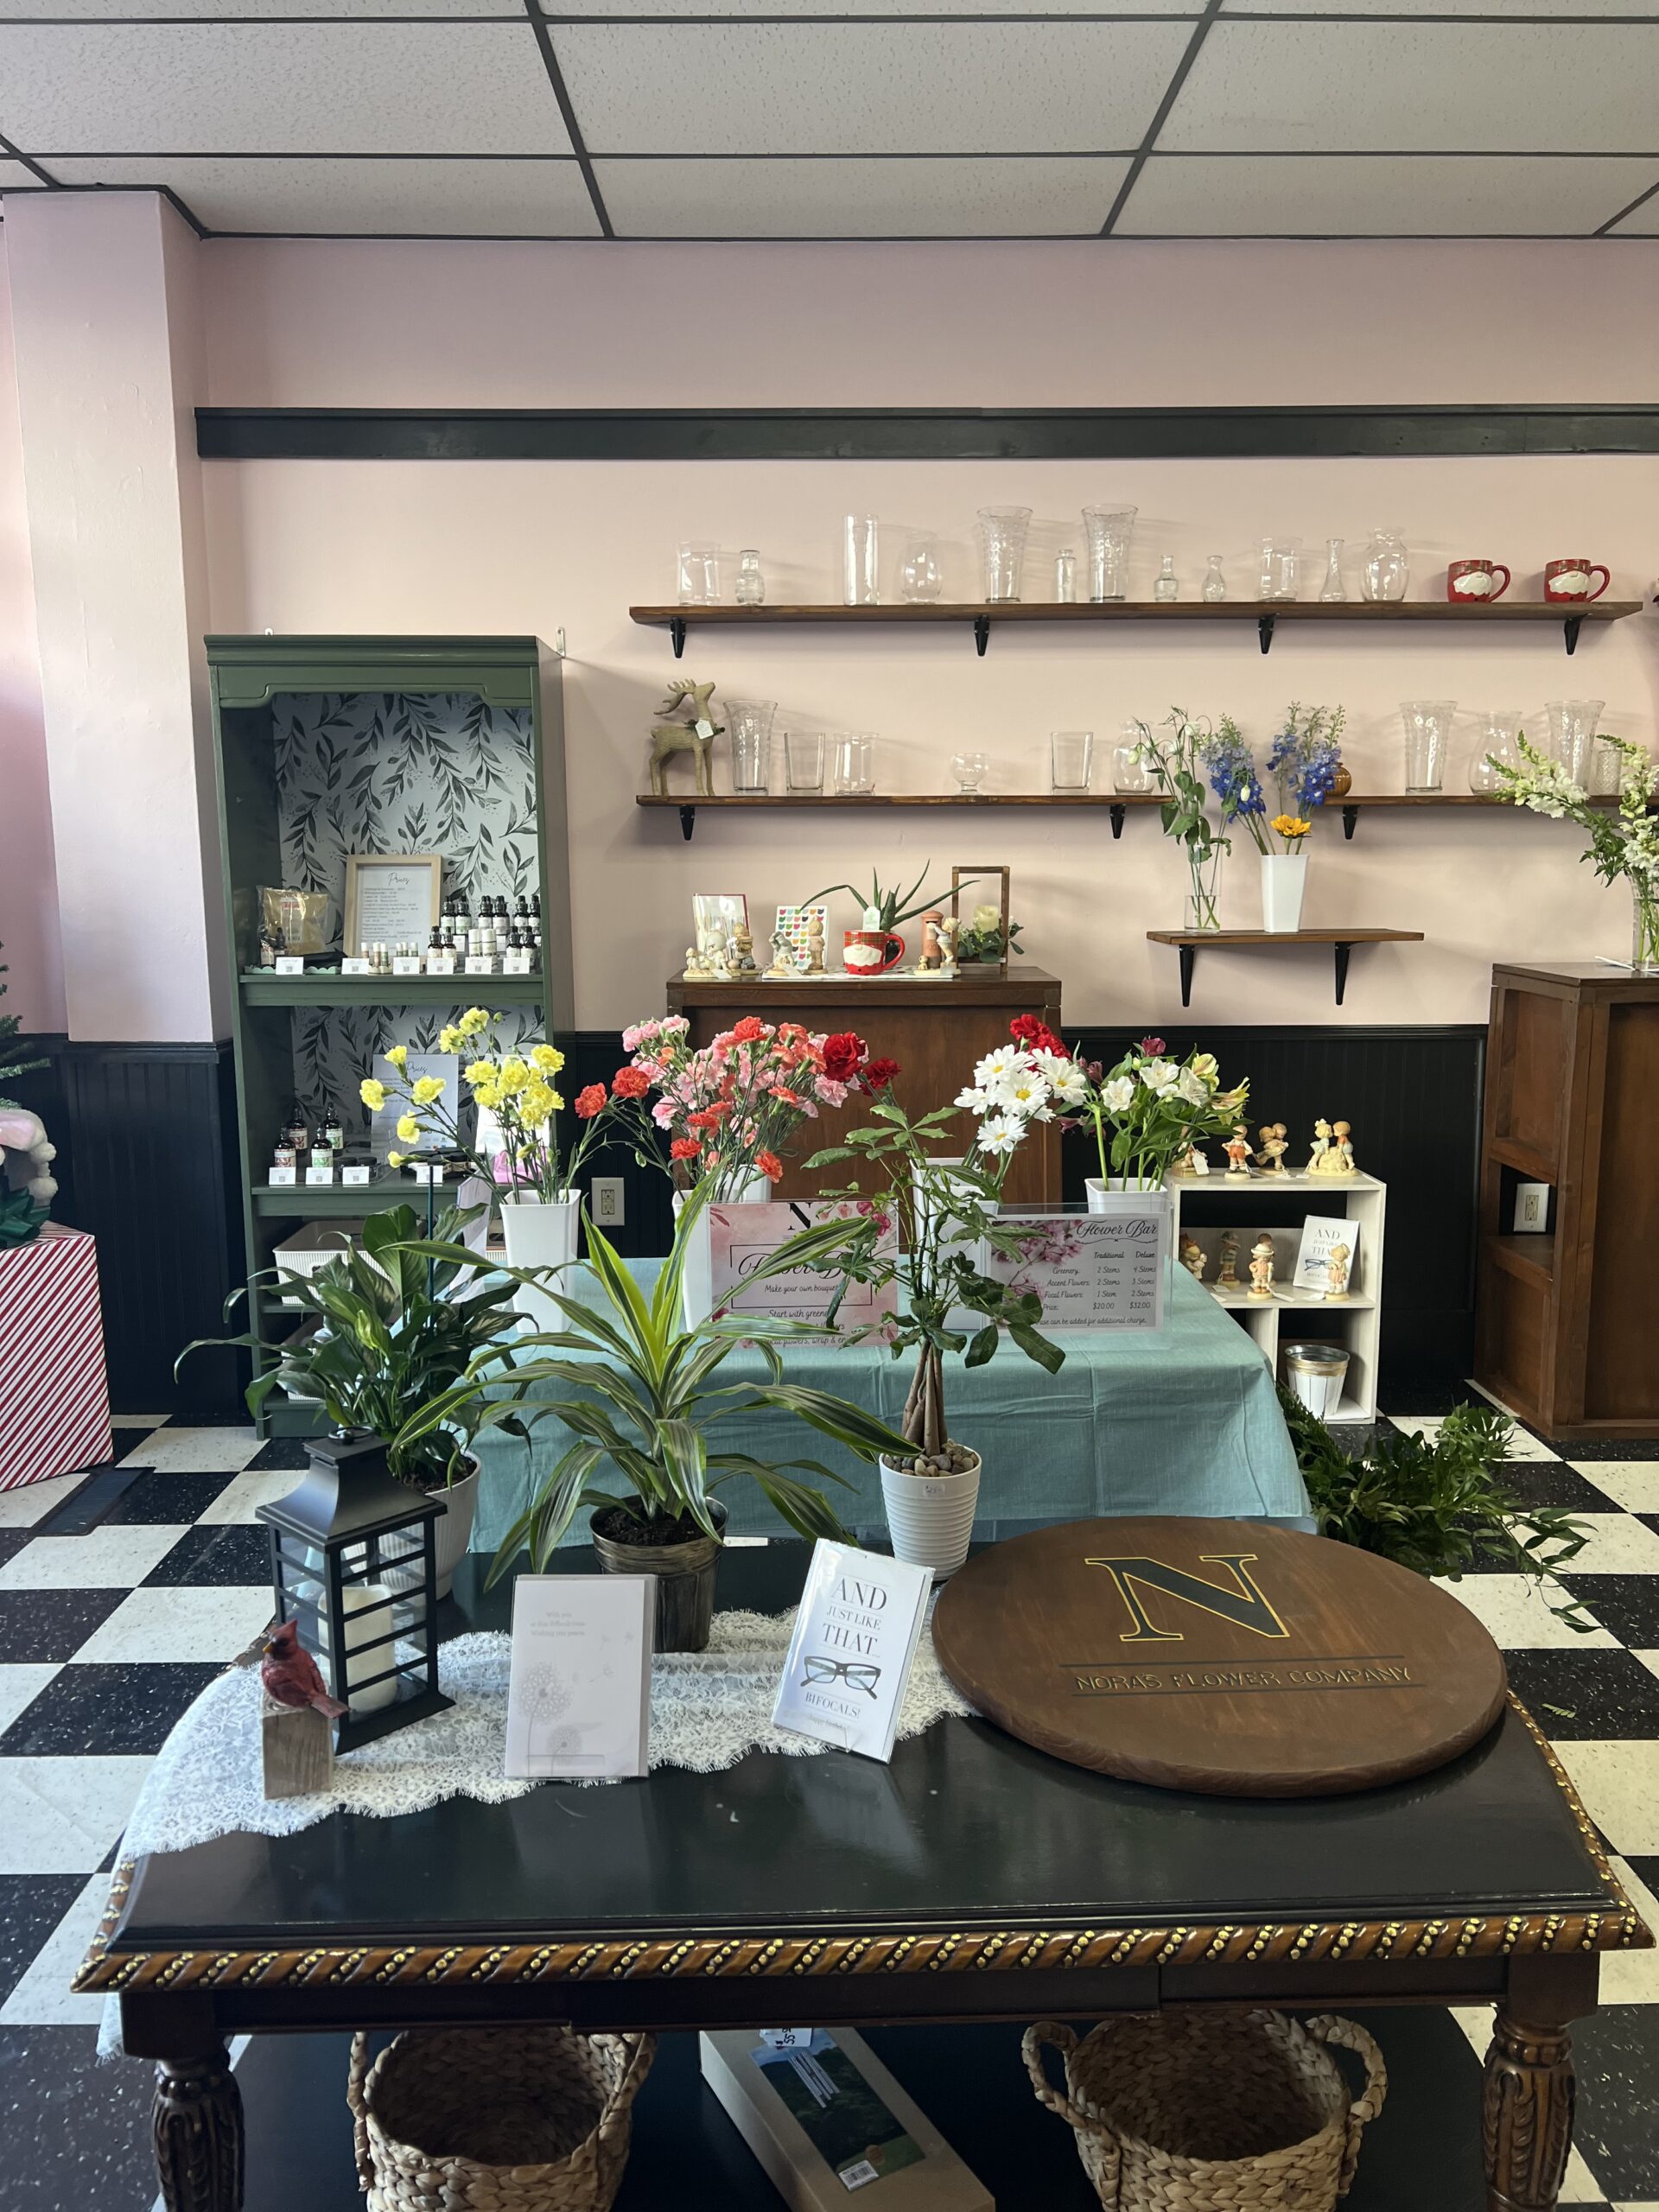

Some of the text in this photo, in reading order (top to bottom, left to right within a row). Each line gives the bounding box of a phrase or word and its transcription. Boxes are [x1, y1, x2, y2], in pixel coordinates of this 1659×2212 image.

[1076, 1219, 1158, 1239] Flower Bar
[1313, 1229, 1340, 1240] AND
[1135, 1250, 1156, 1259] Deluxe
[1313, 1246, 1331, 1256] THA
[1129, 1300, 1151, 1309] $32.00
[767, 1309, 787, 1318] Start
[789, 1309, 804, 1318] with
[1087, 1317, 1096, 1326] for
[830, 1577, 887, 1611] AND
[1084, 1554, 1290, 1642] N
[826, 1605, 882, 1631] JUST LIKE
[1076, 1666, 1411, 1691] NORA'S FLOWER COMPANY
[805, 1691, 861, 1719] BIFOCALS!
